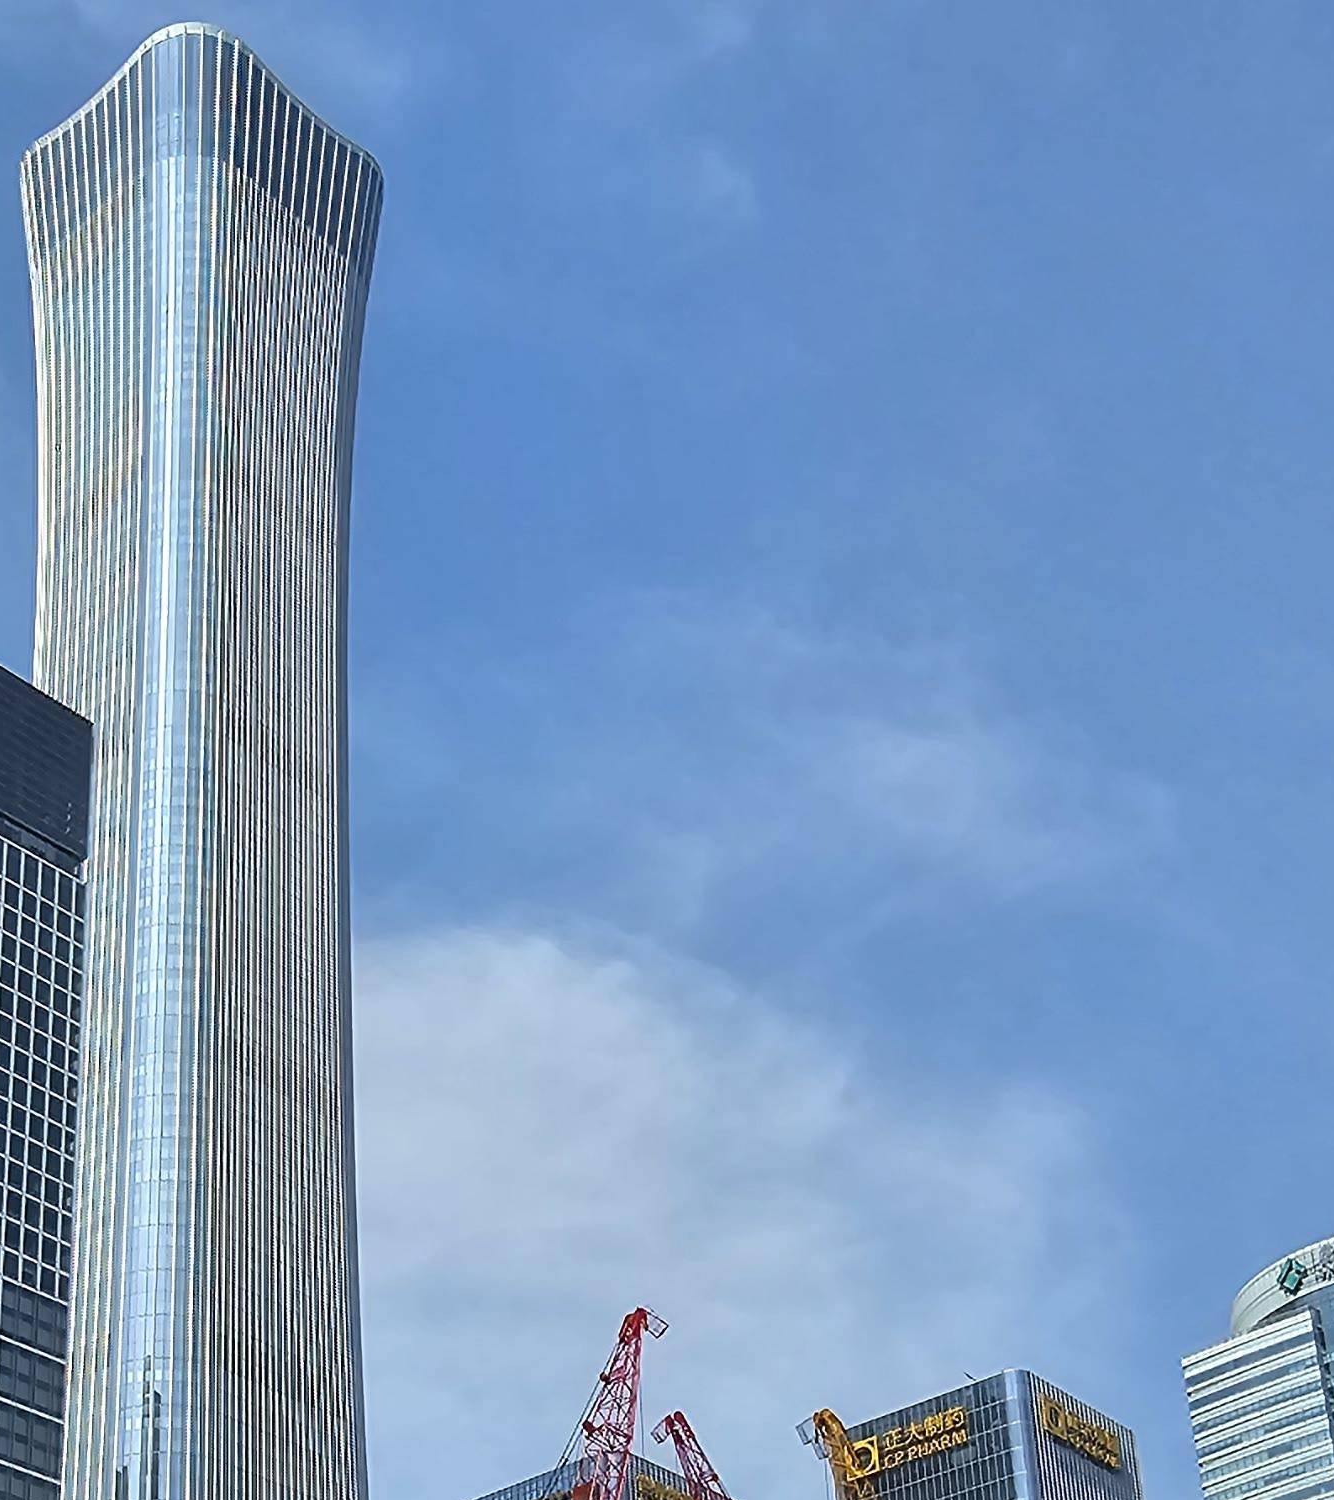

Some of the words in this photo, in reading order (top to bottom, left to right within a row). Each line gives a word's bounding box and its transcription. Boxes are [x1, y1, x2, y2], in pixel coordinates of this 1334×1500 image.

[882, 1406, 965, 1452] 正大制药
[906, 1429, 967, 1461] PHARM
